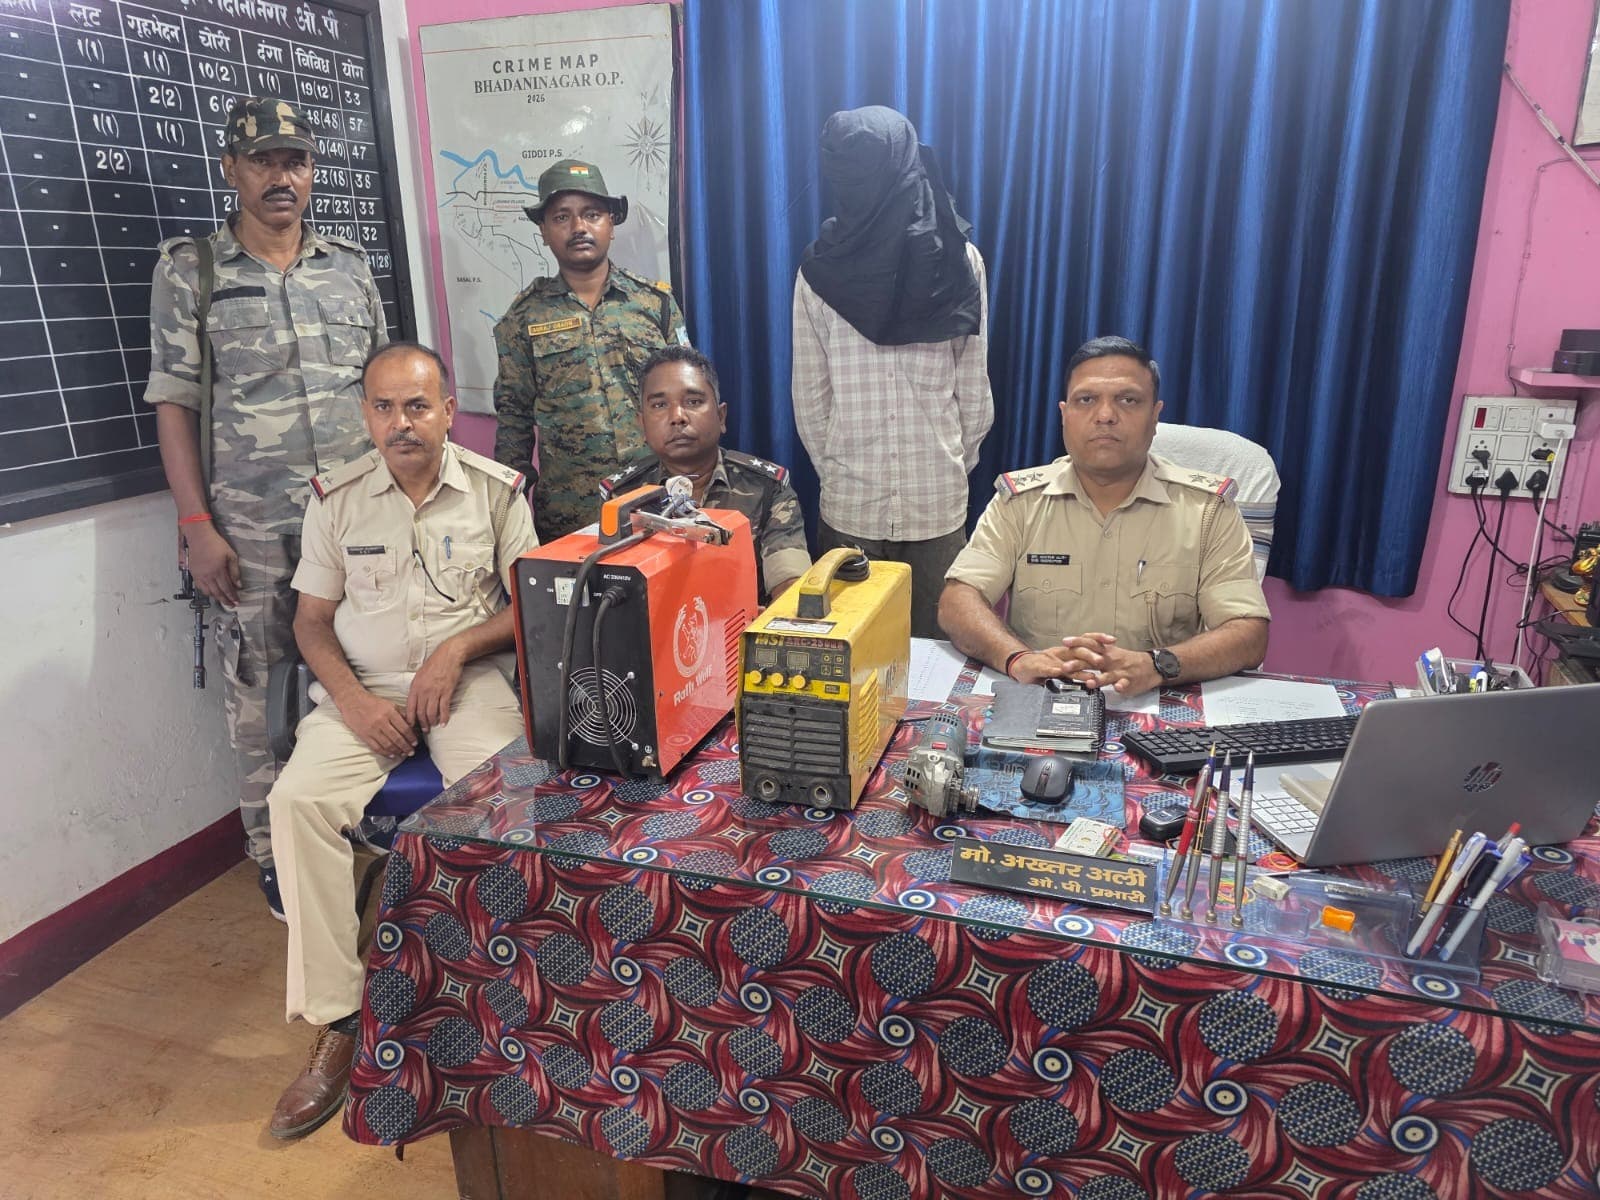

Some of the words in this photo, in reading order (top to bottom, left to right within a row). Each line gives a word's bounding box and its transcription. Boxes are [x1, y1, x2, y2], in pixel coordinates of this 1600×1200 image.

[69, 3, 102, 28] लूट
[126, 14, 180, 44] गृहभेदन
[198, 26, 231, 53] चोरी
[257, 40, 284, 65] दंगा
[294, 47, 332, 74] विविध
[341, 58, 365, 81] योग
[77, 37, 105, 65] 1(1)
[143, 49, 171, 77] 1(1)
[198, 61, 237, 86] 10(2)
[258, 72, 281, 94] 1(1)
[301, 80, 334, 102] 19(12)
[344, 90, 361, 106] 33
[493, 56, 552, 75] CRIME
[560, 53, 599, 70] MAP
[474, 73, 591, 94] BHADANINAGAR
[595, 71, 624, 87] O.P.
[149, 84, 183, 112] 2(2)
[349, 117, 363, 132] 57
[93, 113, 119, 139] 1(1)
[156, 120, 185, 147] 1(1)
[318, 139, 346, 161] 0(40)
[352, 146, 367, 161] 47
[96, 148, 132, 175] 2(2)
[313, 168, 349, 187] 23(18)
[354, 174, 372, 189] 38
[522, 149, 548, 159] GIDDI
[359, 201, 375, 216] 33
[362, 227, 378, 241] 32
[960, 845, 995, 865] मो.
[1000, 853, 1084, 877] अख्तर
[1086, 866, 1148, 888] अली
[1090, 886, 1146, 904] प्रभारी
